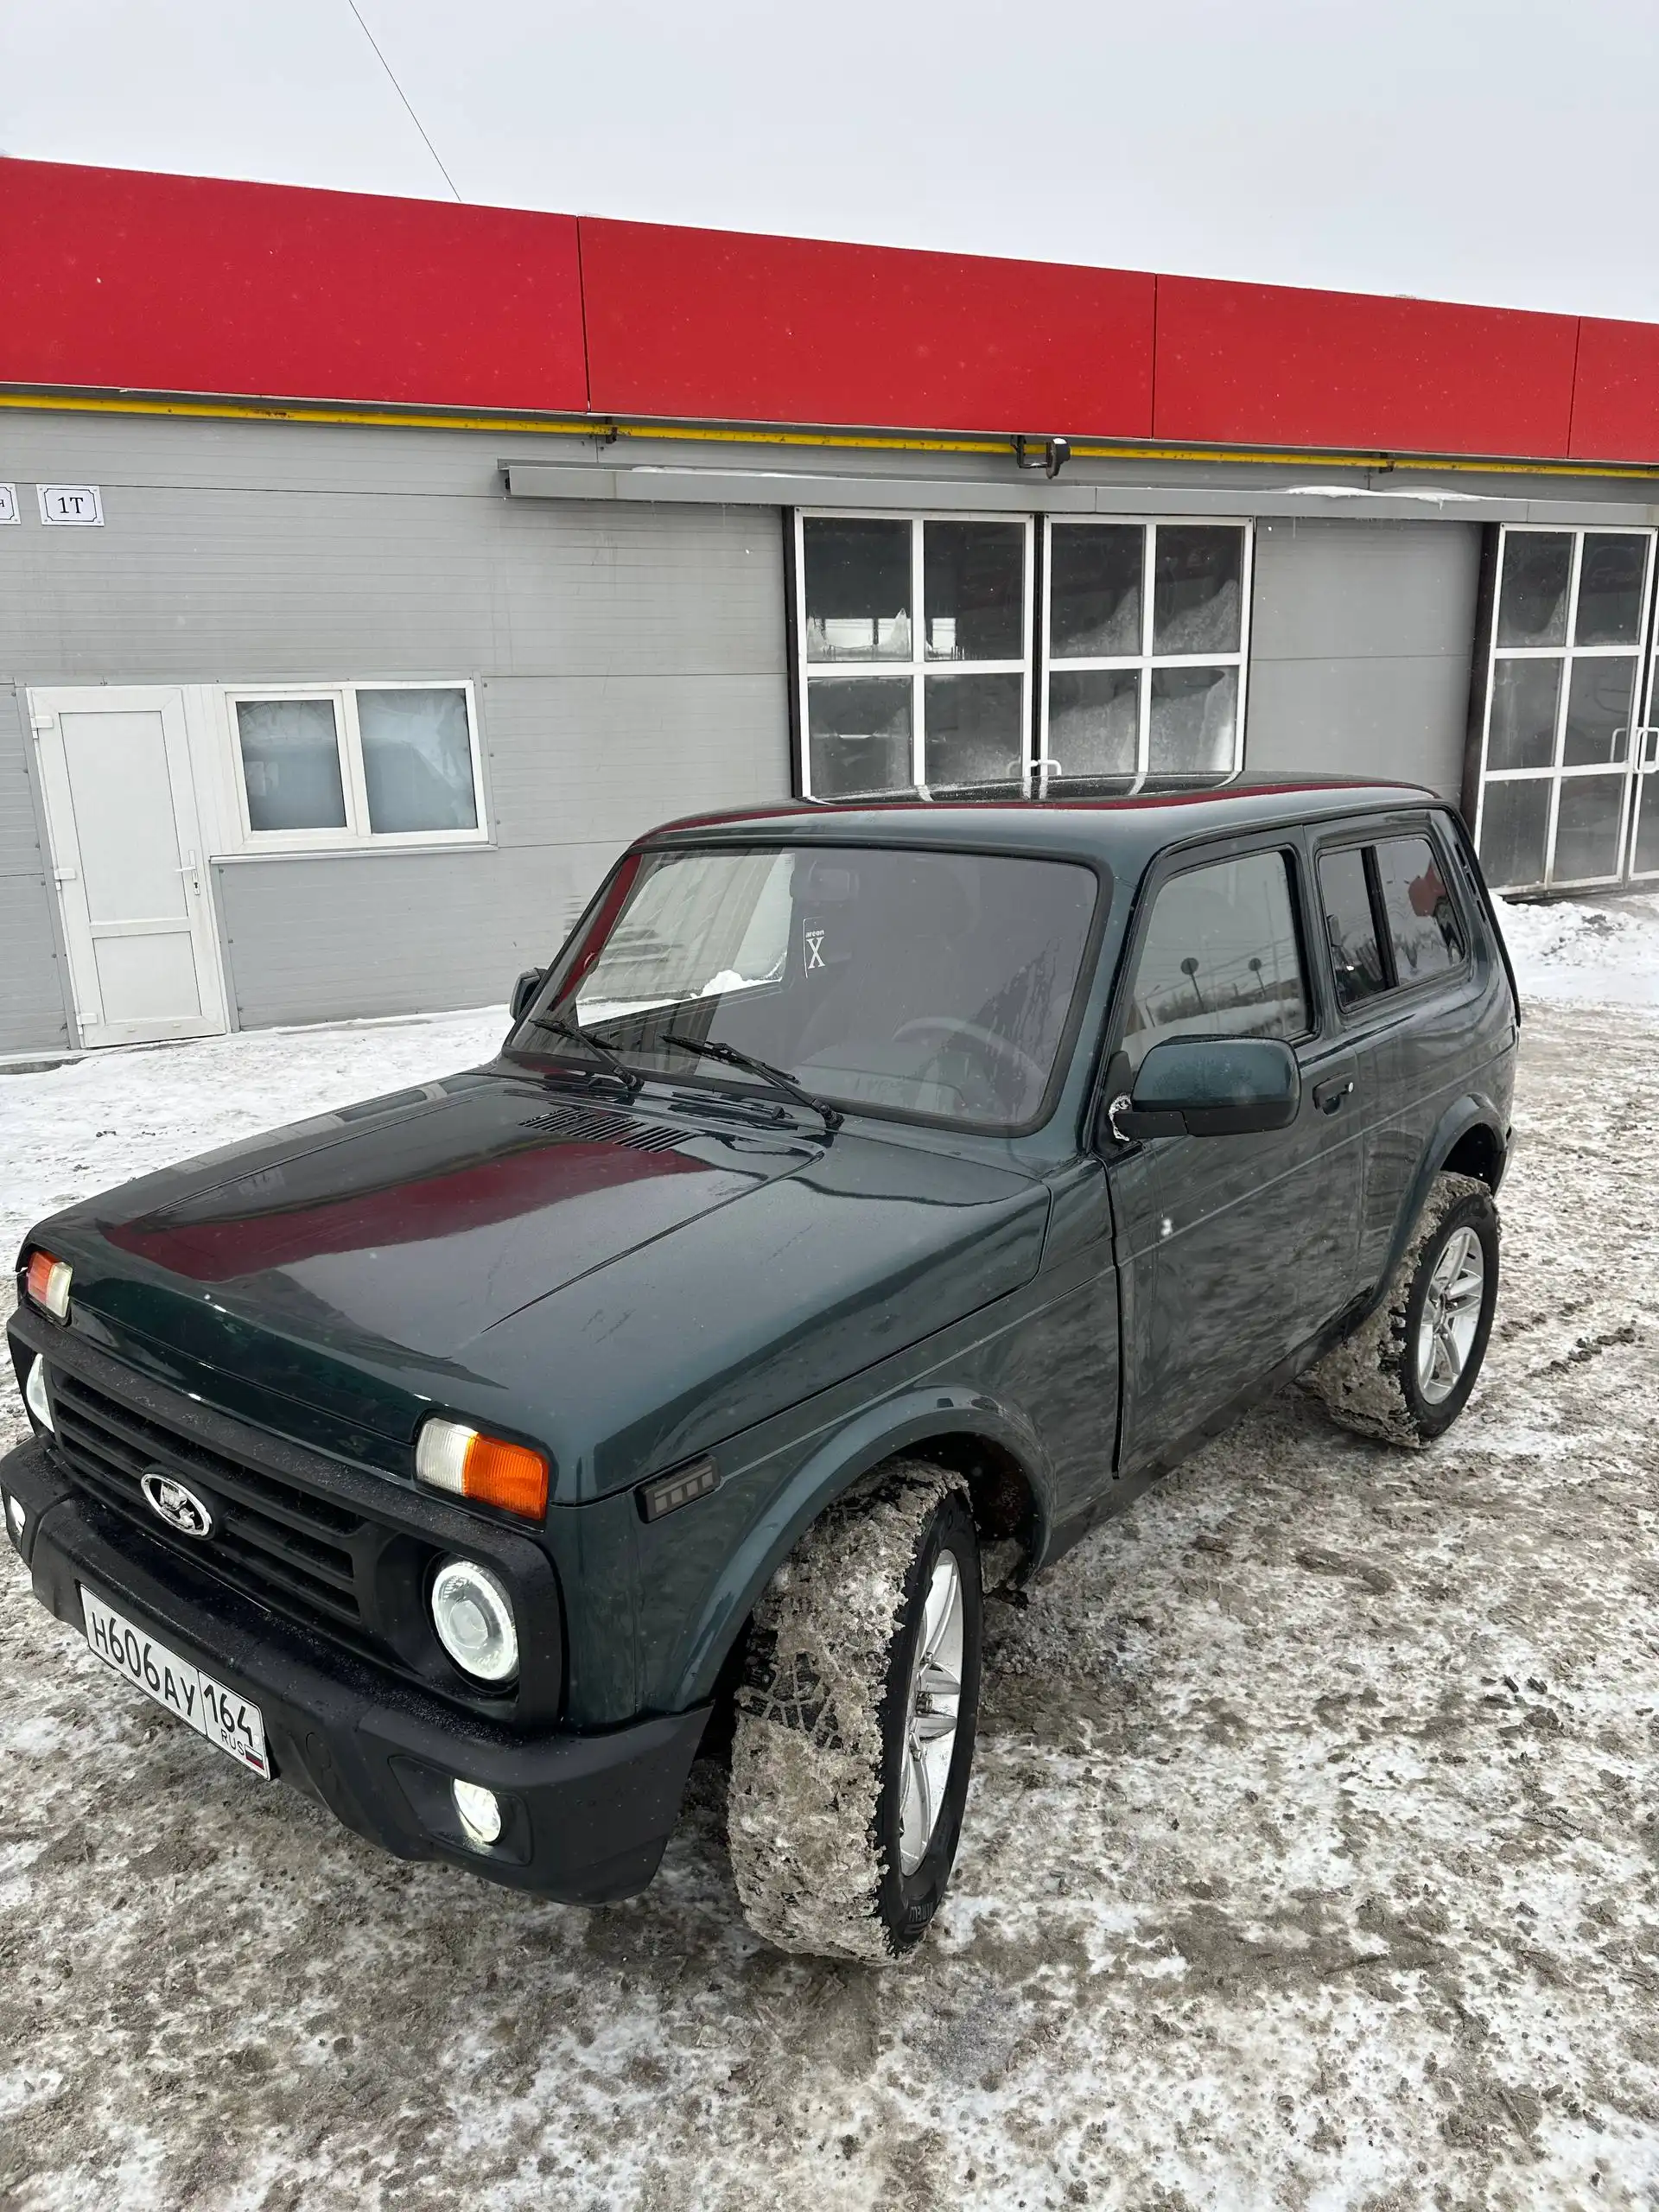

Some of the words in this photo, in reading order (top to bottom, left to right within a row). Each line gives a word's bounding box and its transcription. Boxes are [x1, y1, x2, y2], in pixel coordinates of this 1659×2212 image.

[58, 497, 84, 513] 1Т
[806, 937, 825, 969] X
[92, 1611, 195, 1717] Н606АУ
[204, 1684, 254, 1748] 164
[221, 1728, 245, 1756] RUS
